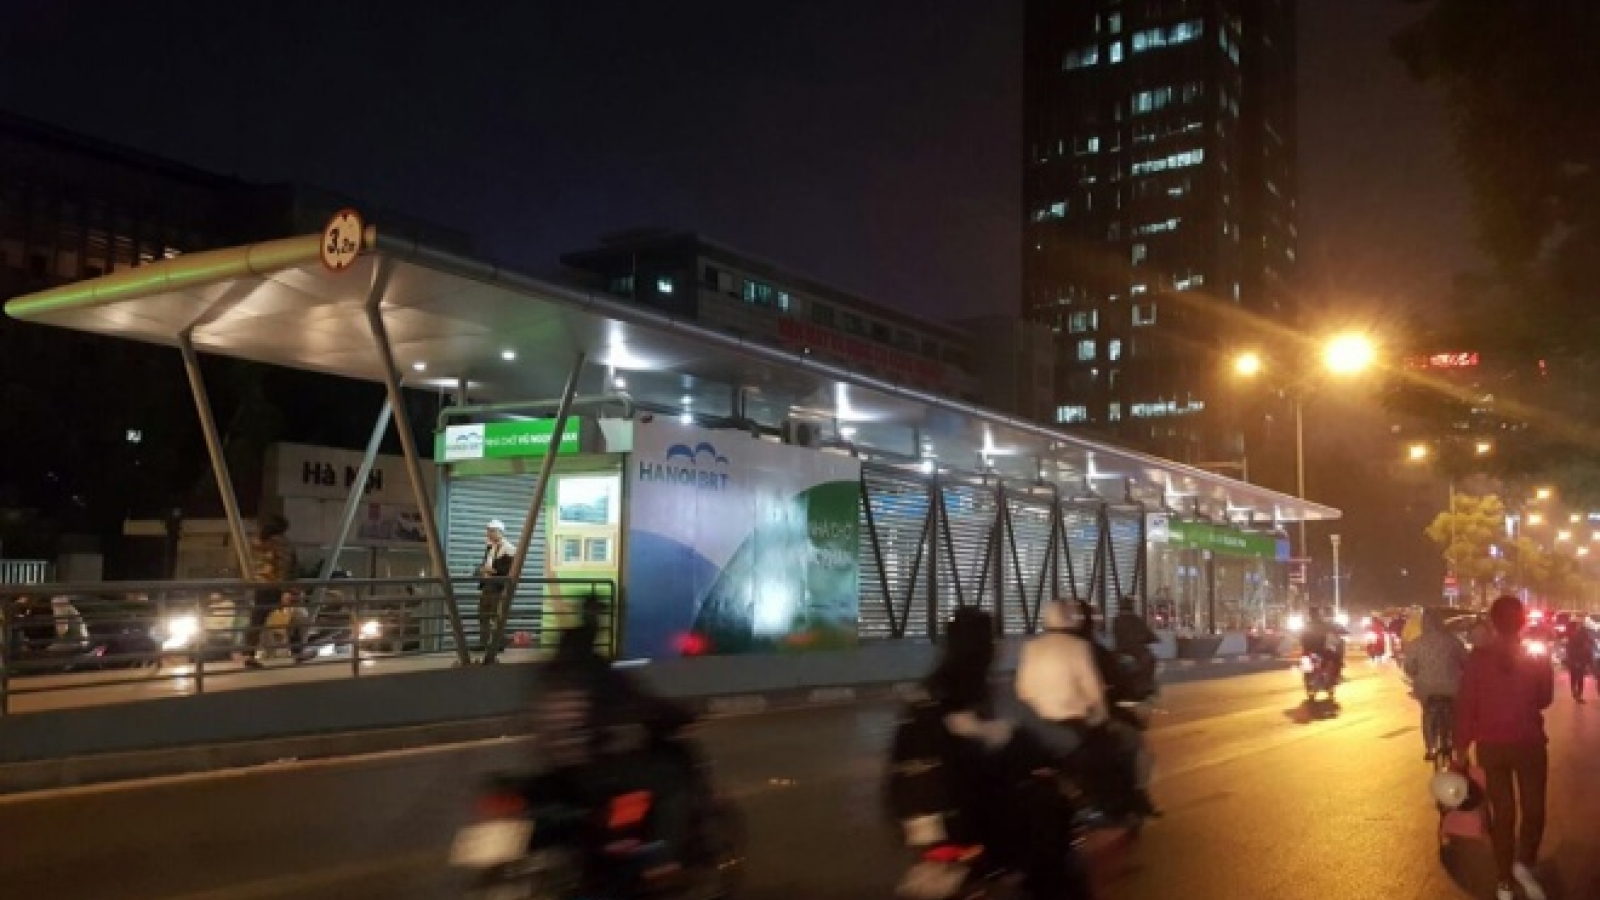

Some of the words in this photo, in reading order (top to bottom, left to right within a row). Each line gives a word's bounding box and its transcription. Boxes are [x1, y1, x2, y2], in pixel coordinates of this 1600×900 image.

[303, 462, 335, 486] Hà
[640, 462, 696, 486] HANOI
[698, 470, 729, 491] BRT
